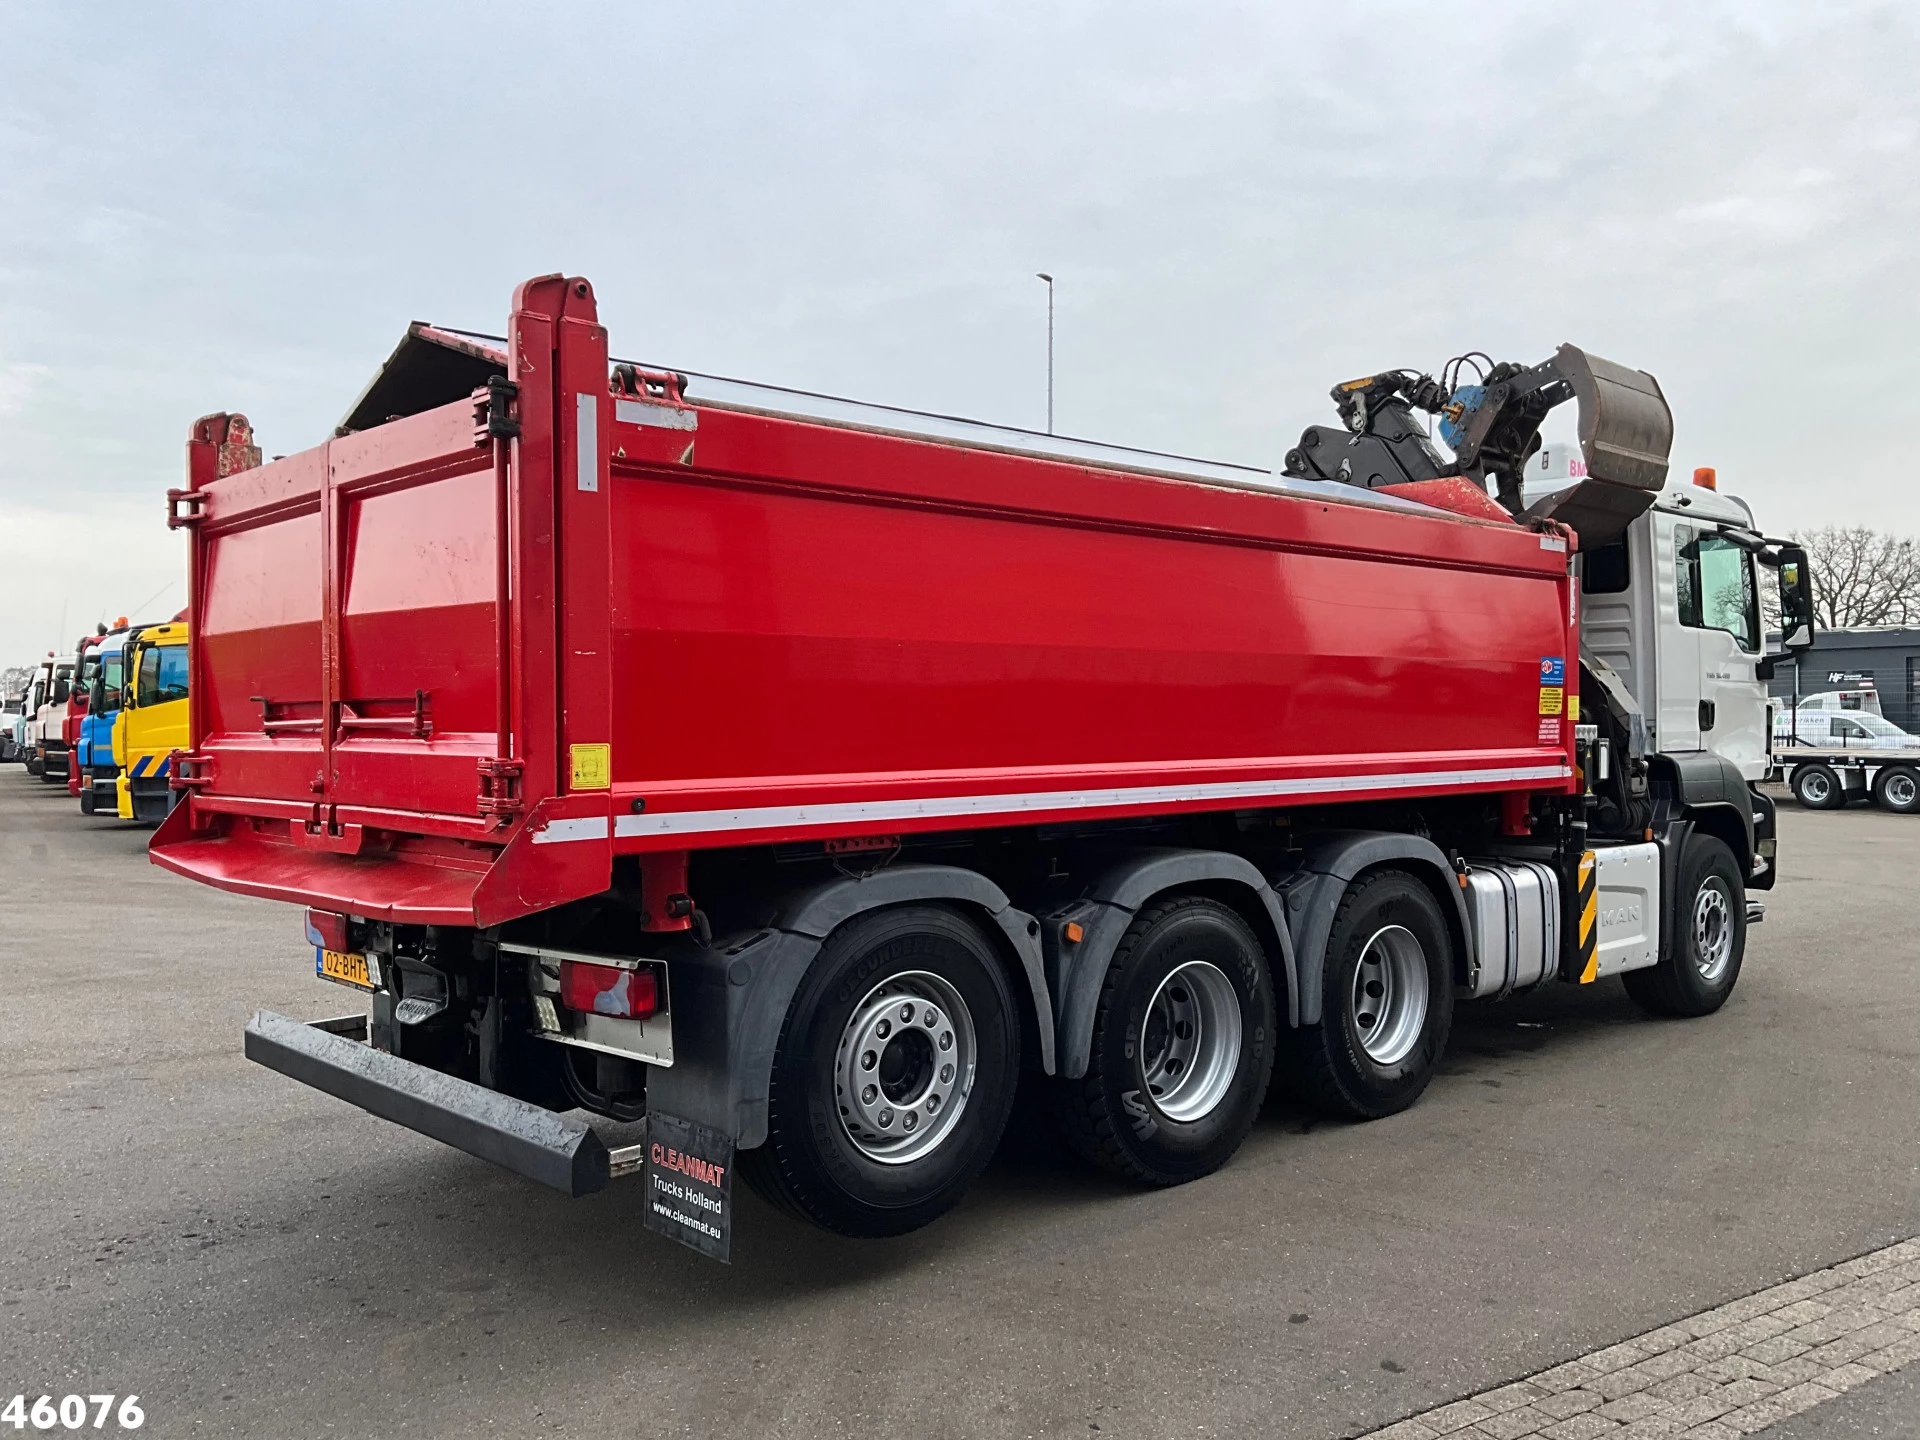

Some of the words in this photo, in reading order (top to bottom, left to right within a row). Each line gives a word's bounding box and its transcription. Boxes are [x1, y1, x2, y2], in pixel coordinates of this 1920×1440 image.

[1569, 459, 1587, 477] BM
[1601, 905, 1640, 928] MAN
[326, 951, 370, 982] 02-BHT-
[651, 1143, 724, 1188] CLEANMAT
[652, 1173, 683, 1199] Trucks
[685, 1187, 721, 1215] Holland
[652, 1201, 721, 1239] www.cleanmat.eu
